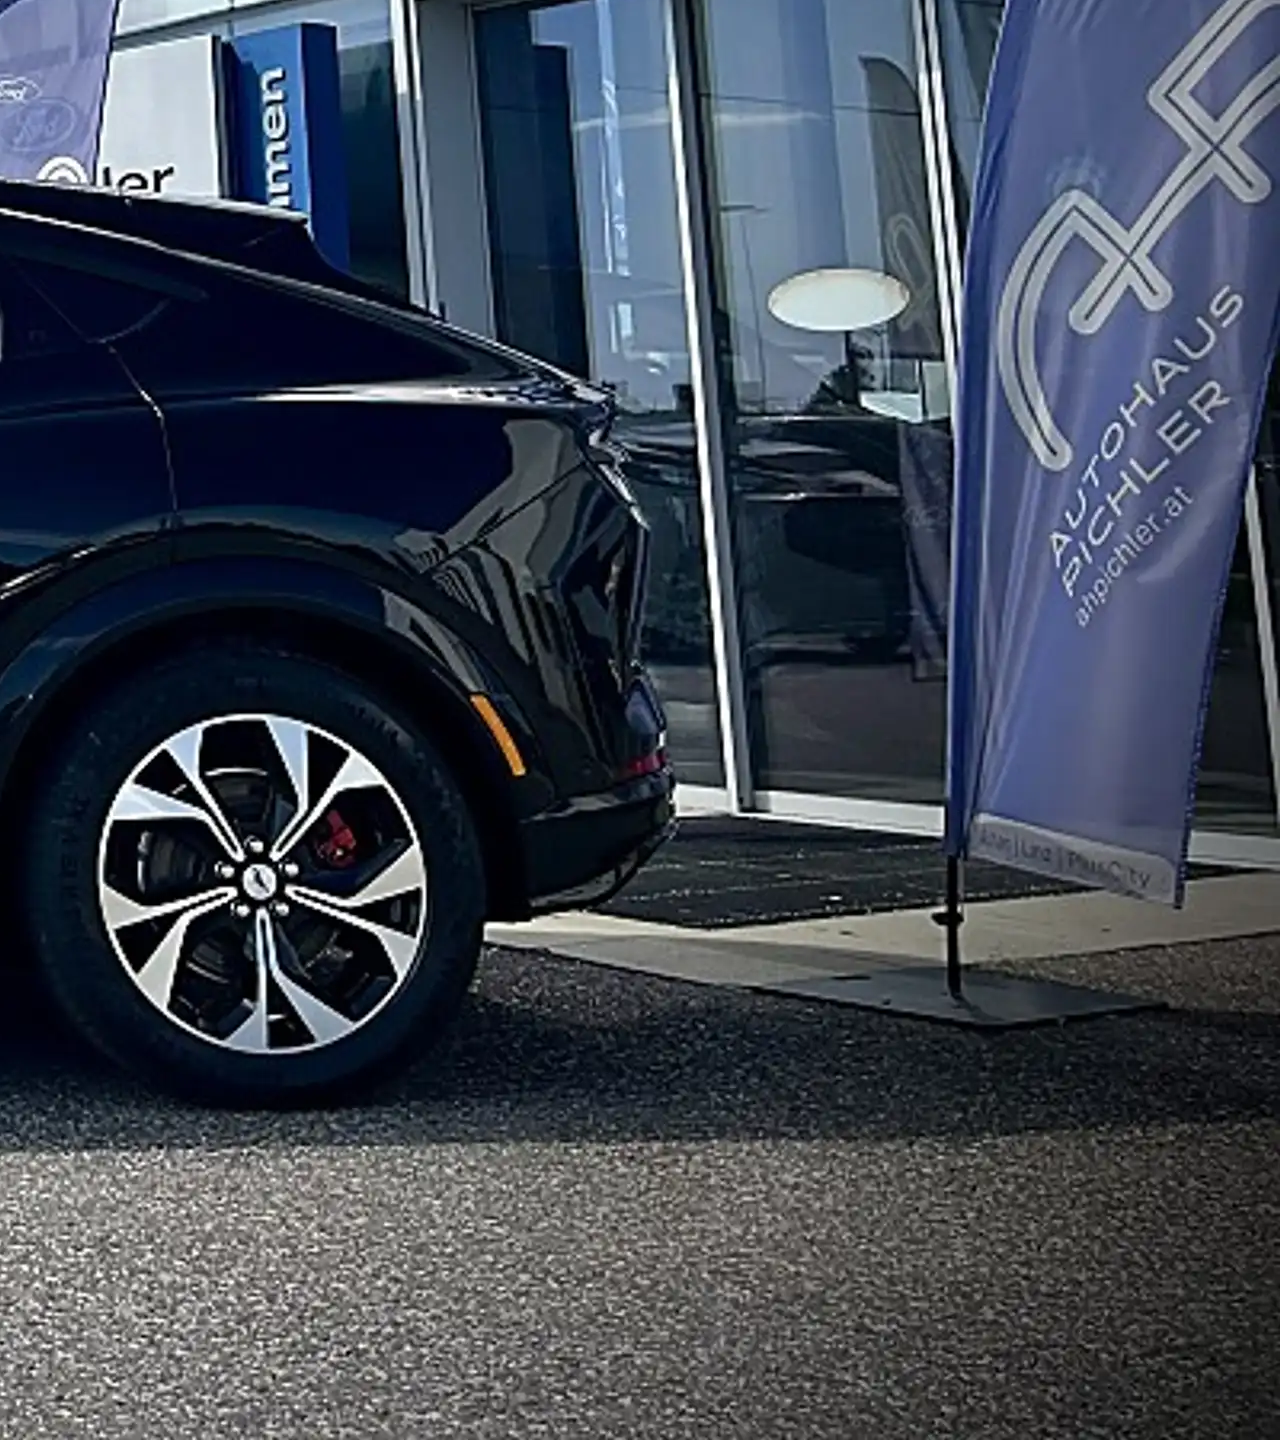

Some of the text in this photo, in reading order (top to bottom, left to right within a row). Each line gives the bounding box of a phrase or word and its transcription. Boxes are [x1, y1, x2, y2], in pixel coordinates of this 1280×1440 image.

[1049, 284, 1244, 568] AUTOHAUS
[1061, 380, 1232, 598] PICHLER
[1075, 486, 1194, 627] ahpichler.at
